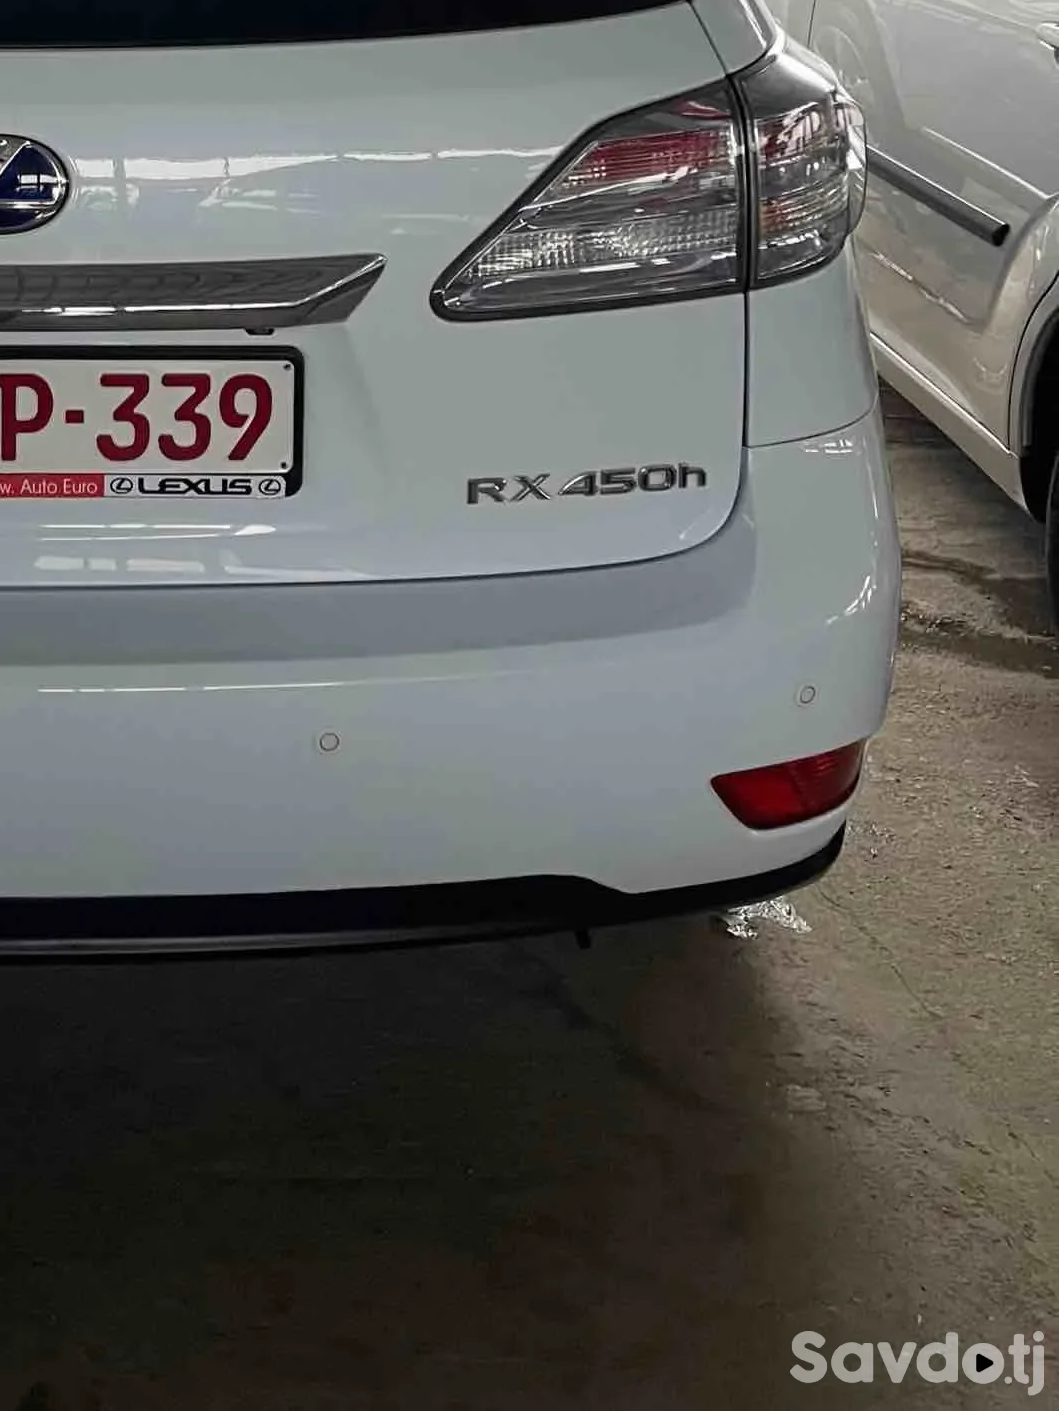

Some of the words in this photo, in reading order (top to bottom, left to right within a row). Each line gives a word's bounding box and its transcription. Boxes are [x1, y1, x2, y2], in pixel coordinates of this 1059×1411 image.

[20, 478, 58, 495] Auto
[63, 478, 98, 495] Euro
[137, 477, 253, 496] LEXUS
[466, 472, 552, 506] RX
[557, 462, 708, 497] 450h
